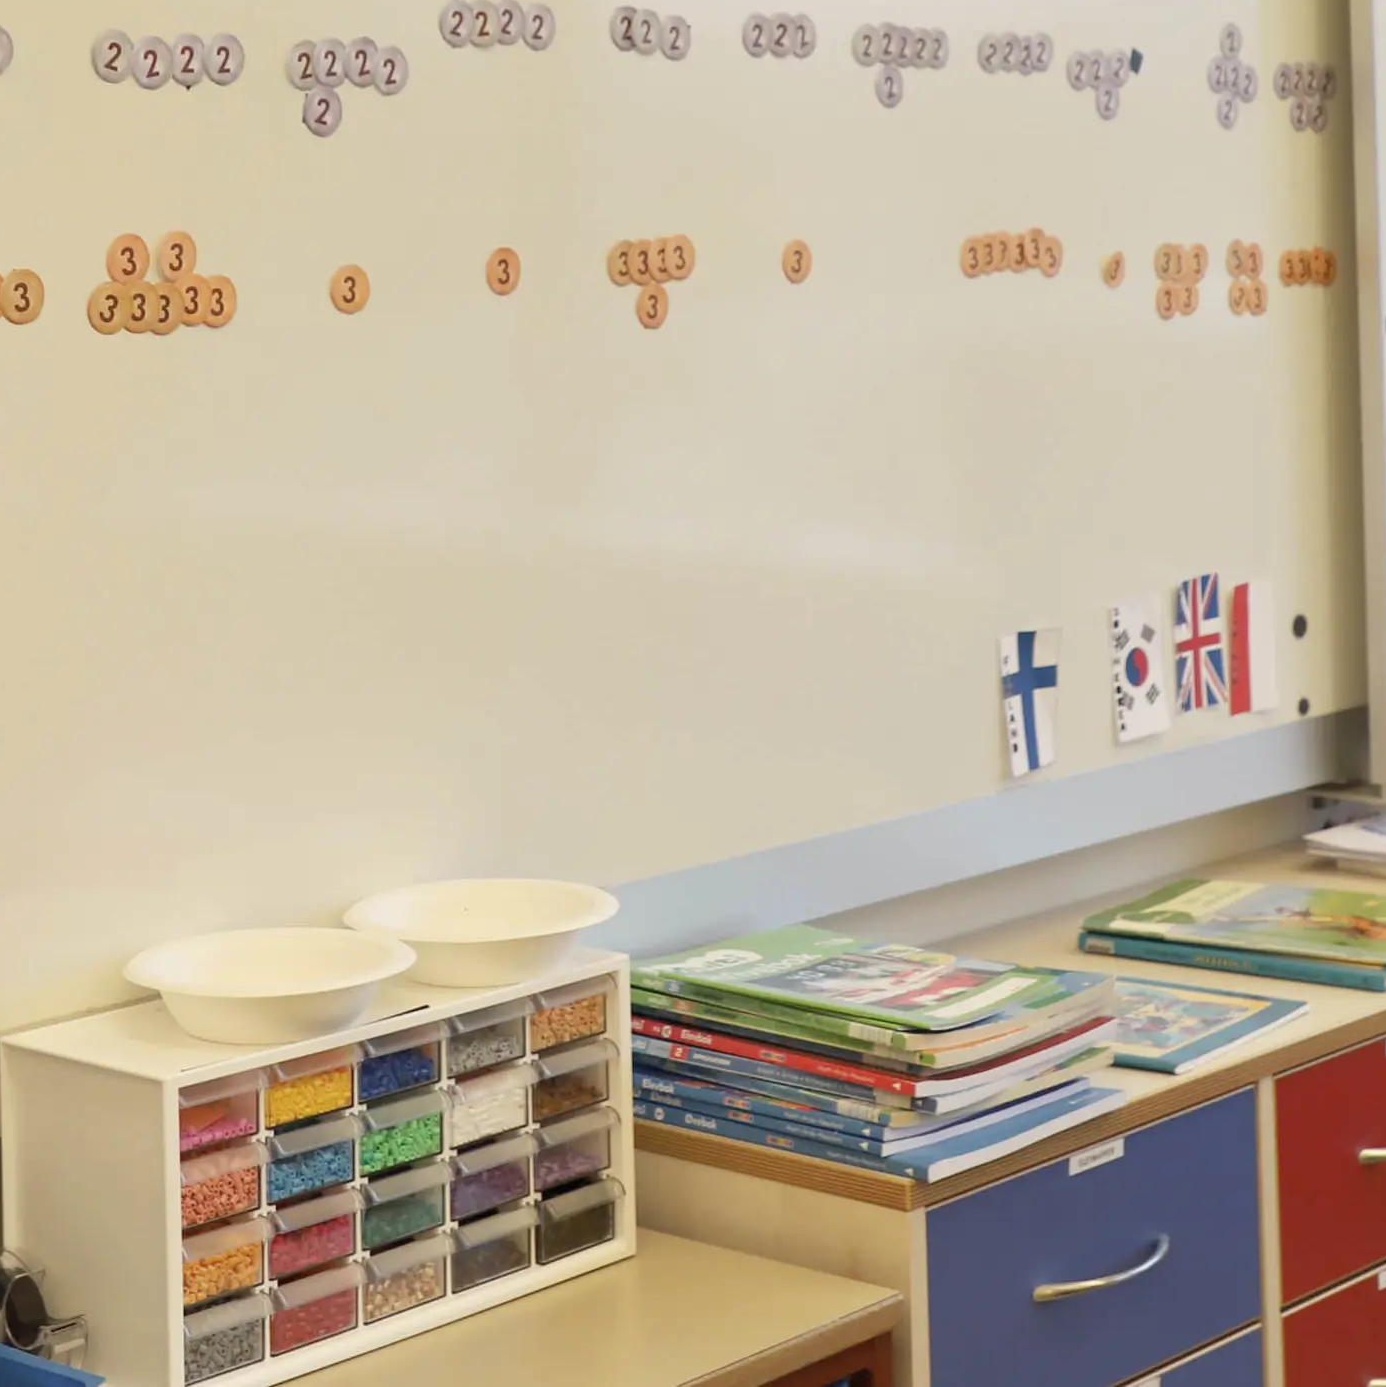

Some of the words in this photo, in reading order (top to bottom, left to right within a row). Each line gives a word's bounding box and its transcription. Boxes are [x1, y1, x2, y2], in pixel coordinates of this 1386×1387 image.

[447, 9, 465, 39] 2
[473, 9, 491, 39] 2
[499, 7, 515, 37] 2
[530, 13, 545, 42] 2
[618, 14, 634, 43] 2
[639, 17, 653, 46] 2
[668, 25, 682, 52] 2
[102, 40, 123, 73] 2
[142, 48, 162, 80] 2
[179, 44, 196, 75] 2
[215, 44, 232, 75] 2
[296, 50, 315, 81] 2
[323, 48, 339, 79] 2
[353, 47, 372, 79] 2
[382, 57, 398, 87] 2
[312, 97, 332, 127] 2
[119, 245, 138, 277] 3
[167, 241, 185, 273] 3
[496, 257, 511, 286] 3
[616, 249, 630, 278] 3
[636, 249, 649, 278] 3
[655, 246, 668, 276] 3
[672, 244, 688, 272] 3
[789, 248, 805, 276] 3
[12, 281, 32, 314] 3
[98, 293, 120, 324] 3
[130, 292, 147, 323] 3
[156, 293, 172, 325] 3
[183, 284, 200, 316] 3
[209, 286, 226, 318] 3
[341, 274, 357, 305] 3
[644, 292, 660, 322] 3
